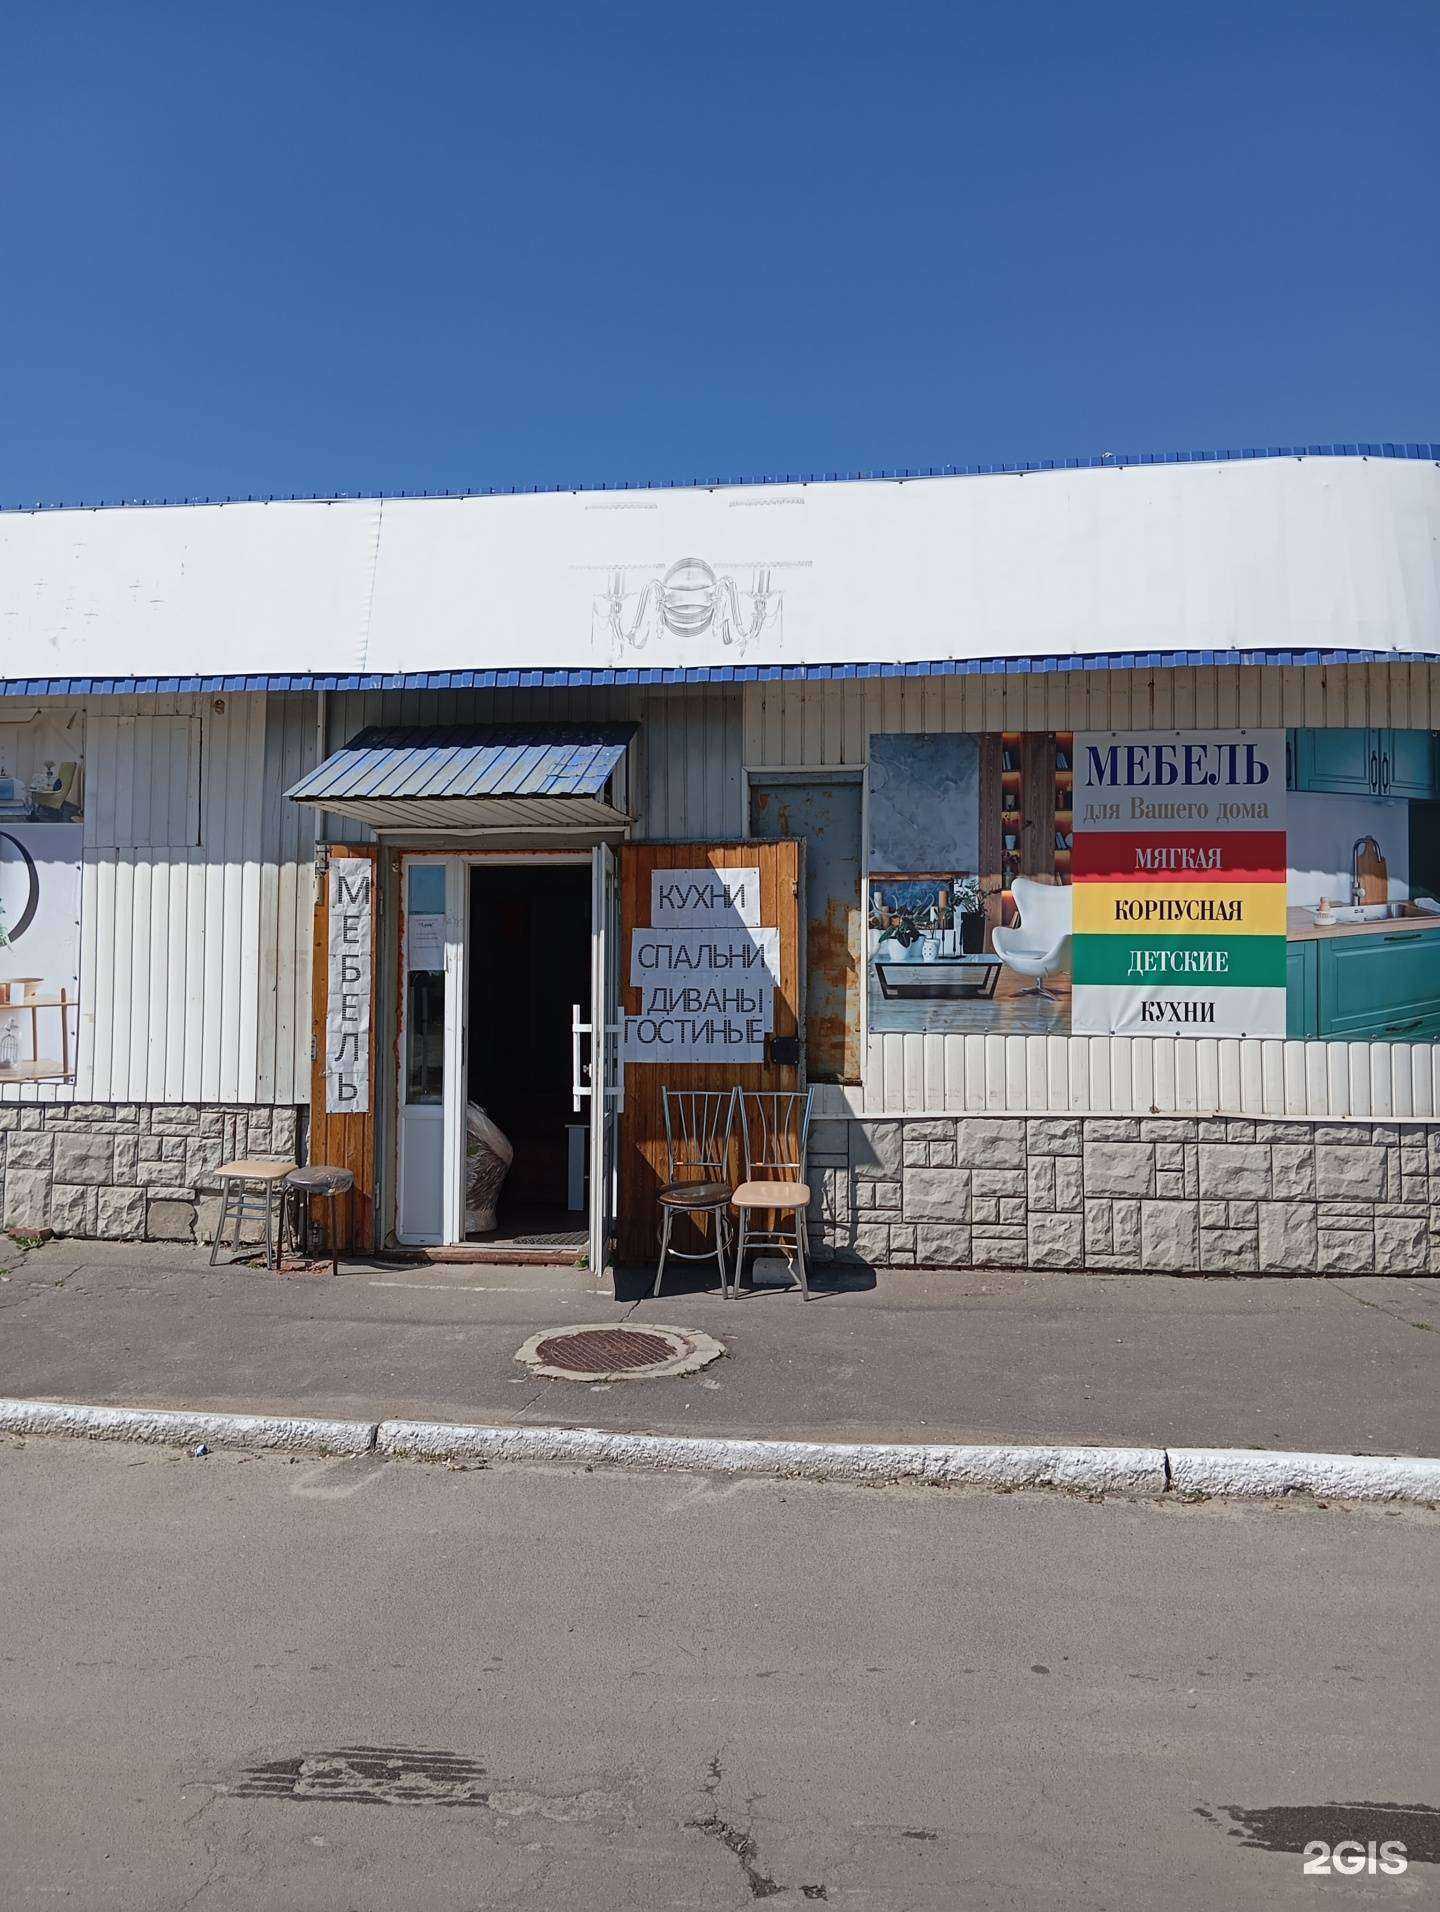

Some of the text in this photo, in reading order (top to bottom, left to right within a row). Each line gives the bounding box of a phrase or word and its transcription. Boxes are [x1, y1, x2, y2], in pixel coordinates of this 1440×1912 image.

[1085, 743, 1269, 786] МЕБЕЛЬ
[1083, 797, 1269, 824] для Вашего дома
[1135, 847, 1222, 869] МЯГКАЯ
[659, 884, 746, 909] КУХНИ
[1115, 899, 1244, 921] КОРПУСНАЯ
[637, 943, 766, 969] СПАЛЬНИ
[1127, 950, 1229, 976] ДЕТСКИЕ
[335, 875, 370, 1102] МЕБЕЛЬ
[647, 987, 764, 1016] ДИВАНЫ
[1140, 1000, 1216, 1023] КУХНИ
